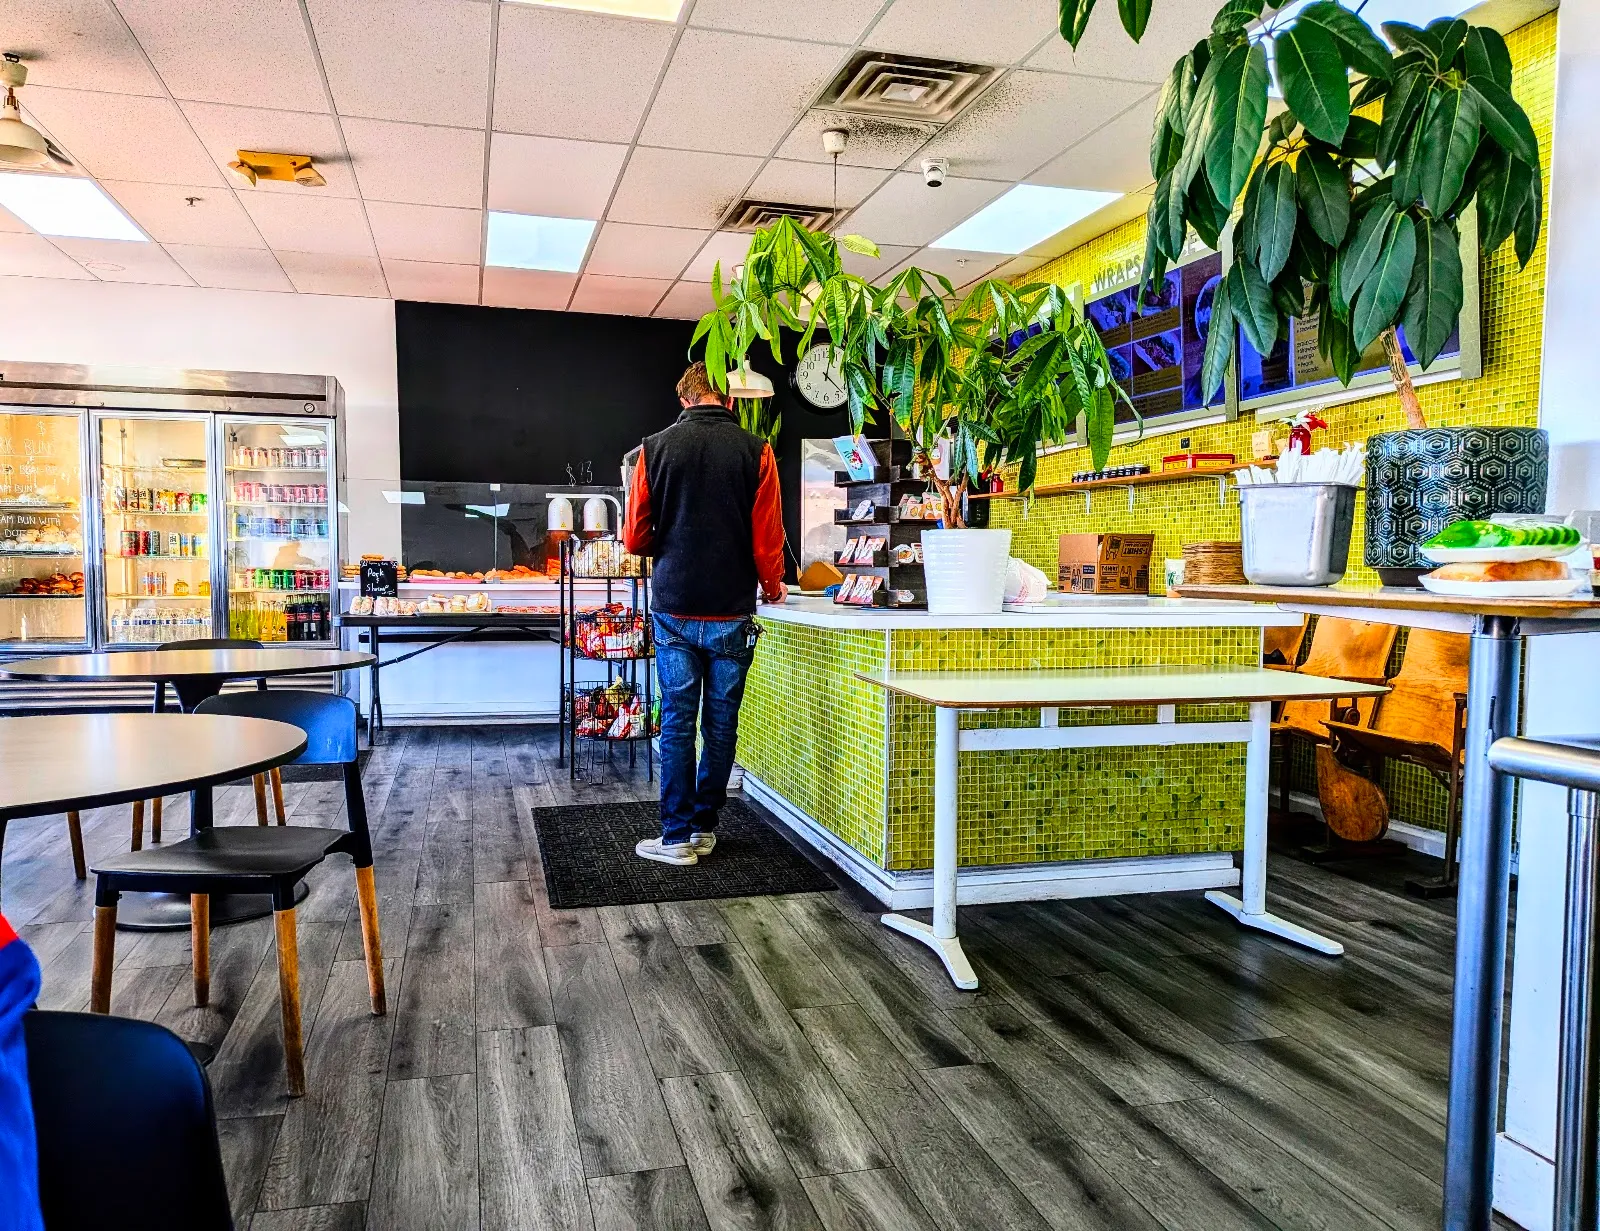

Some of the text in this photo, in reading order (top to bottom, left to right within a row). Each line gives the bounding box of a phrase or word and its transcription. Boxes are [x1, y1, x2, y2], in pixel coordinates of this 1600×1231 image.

[1094, 254, 1141, 291] WRAPS
[814, 354, 820, 362] 11
[806, 362, 814, 370] 10
[802, 370, 808, 380] 9
[806, 382, 812, 390] 8
[814, 390, 820, 398] 7
[824, 392, 830, 402] 6
[834, 390, 840, 400] 5
[17, 515, 36, 525] BUN
[38, 516, 61, 527] WITH
[1123, 547, 1148, 555] T-SHIRT
[367, 568, 384, 578] Pork
